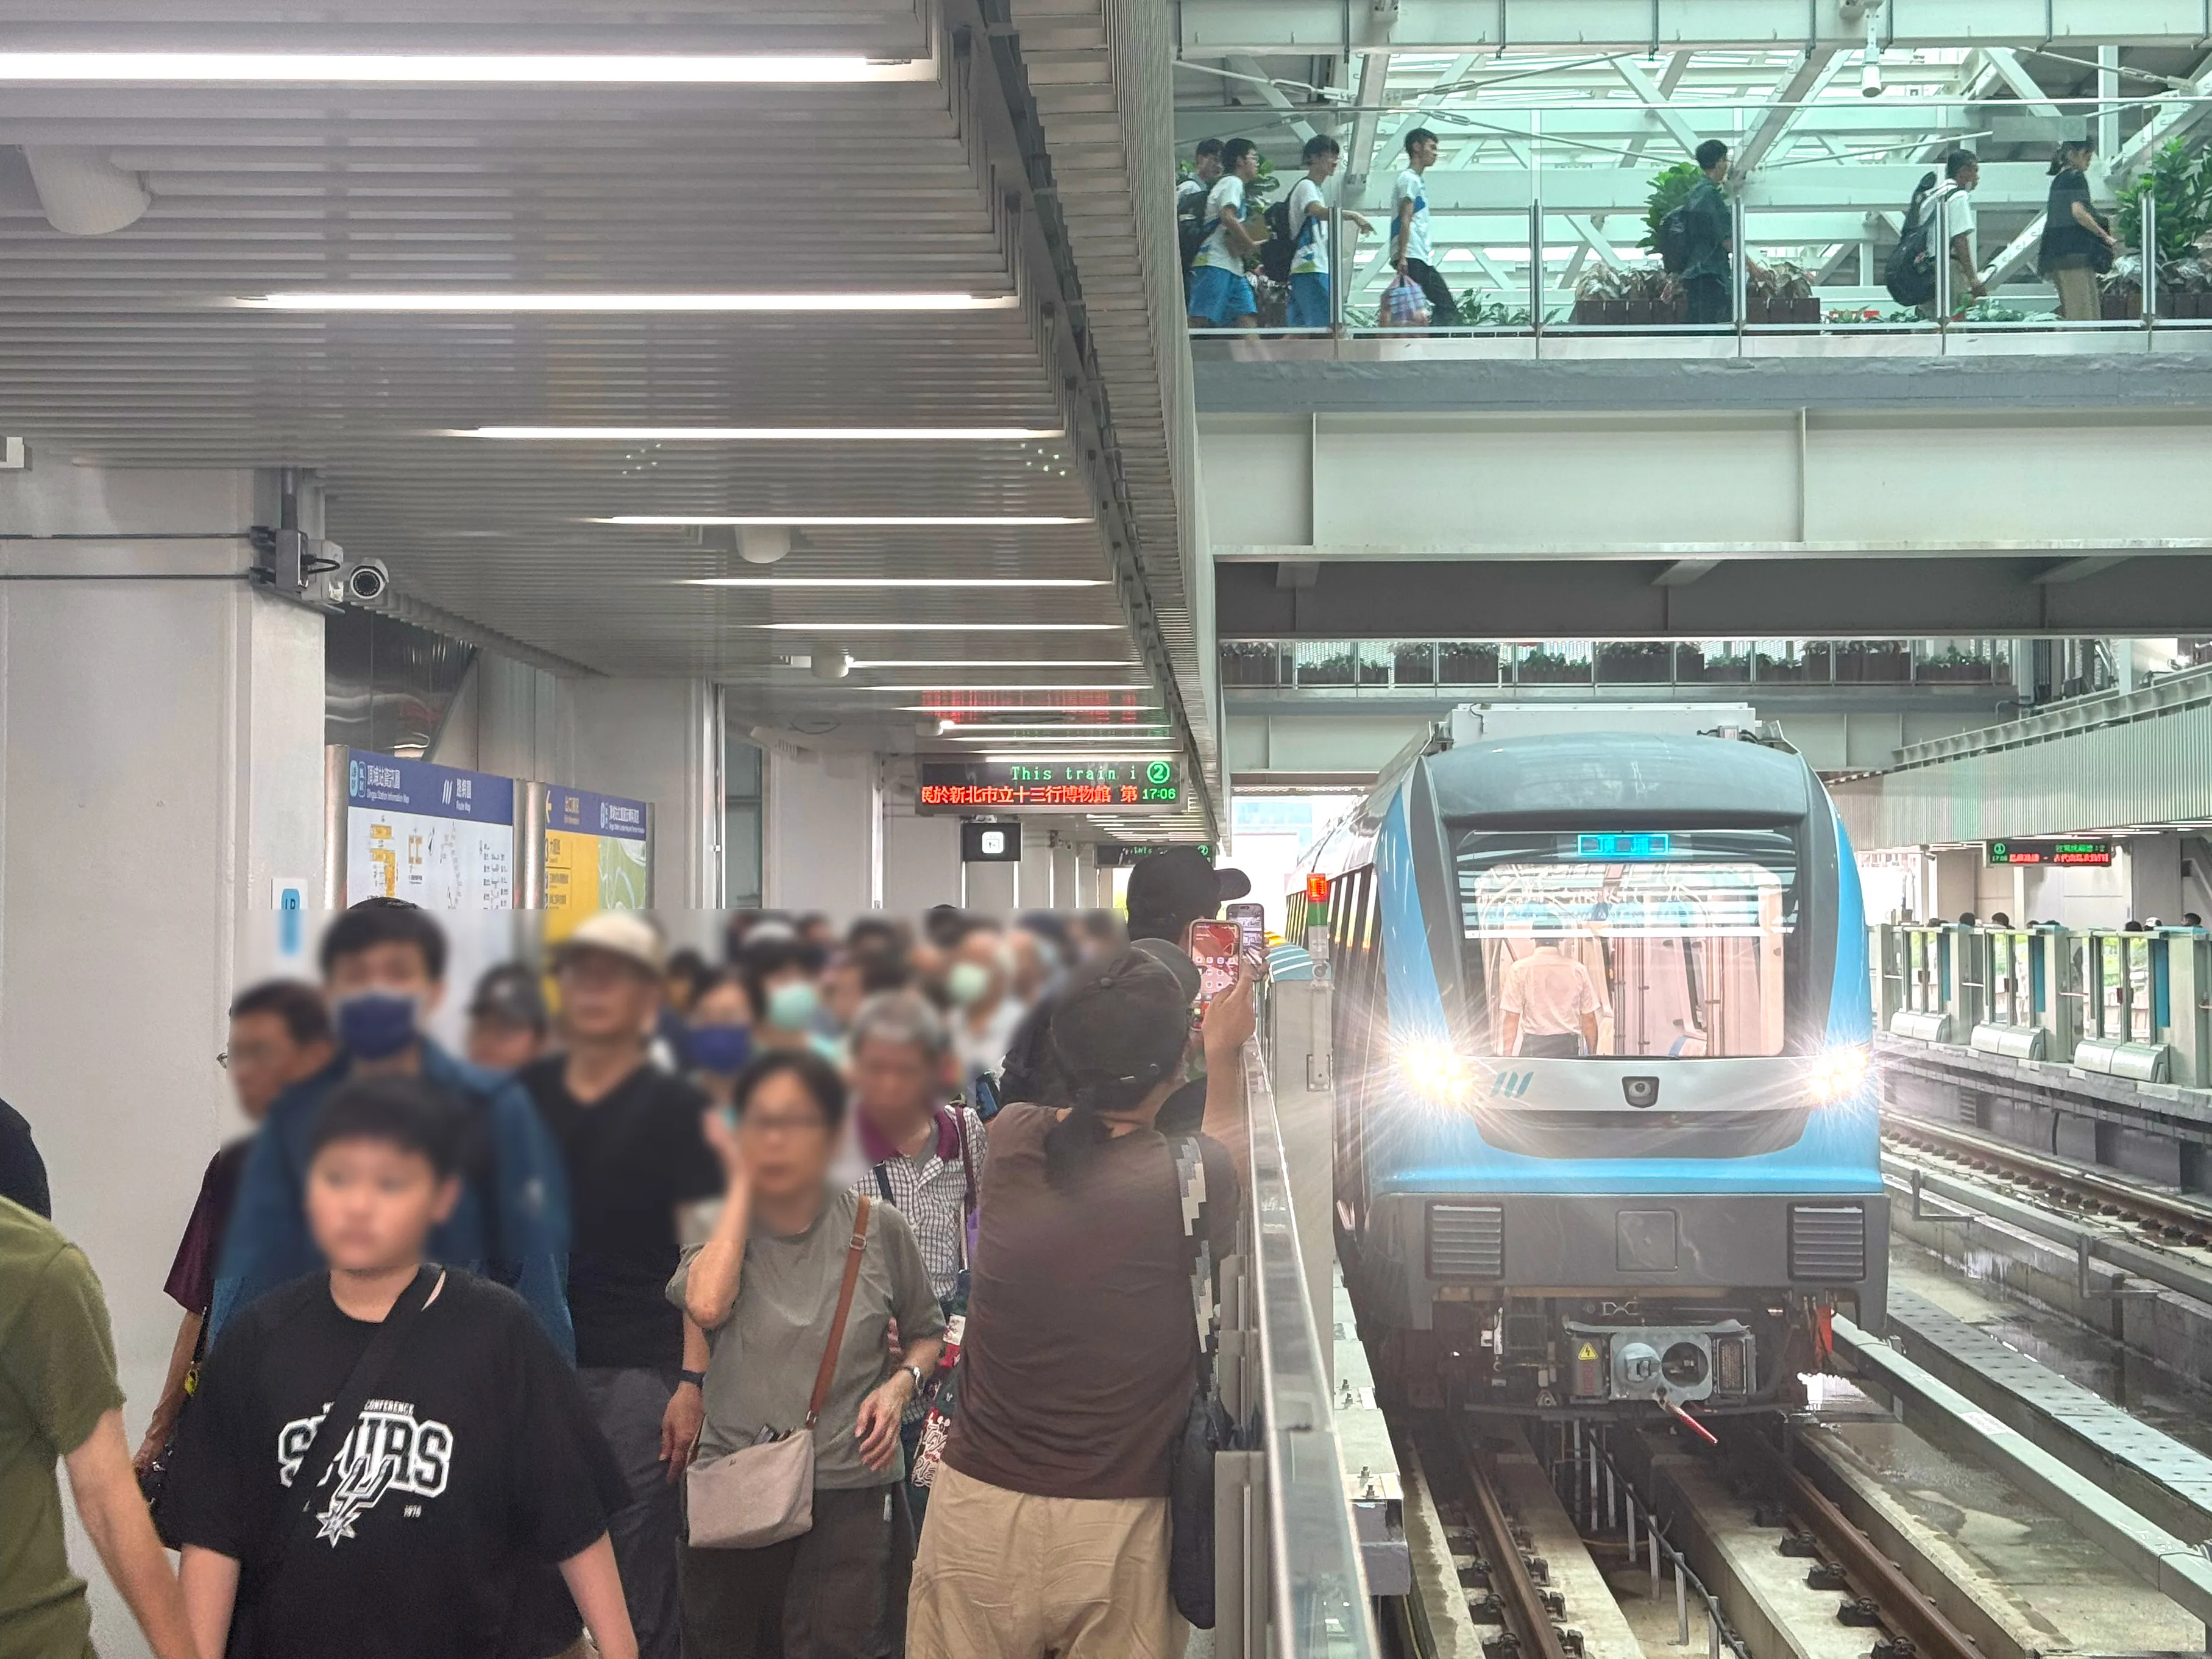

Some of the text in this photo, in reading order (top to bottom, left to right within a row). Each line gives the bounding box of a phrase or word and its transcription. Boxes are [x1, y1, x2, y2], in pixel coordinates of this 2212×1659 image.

[1012, 766, 1052, 780] This
[1066, 766, 1116, 780] train
[1120, 784, 1138, 803] 第
[1142, 788, 1176, 800] 17:06
[363, 1399, 415, 1415] CONFERENCE
